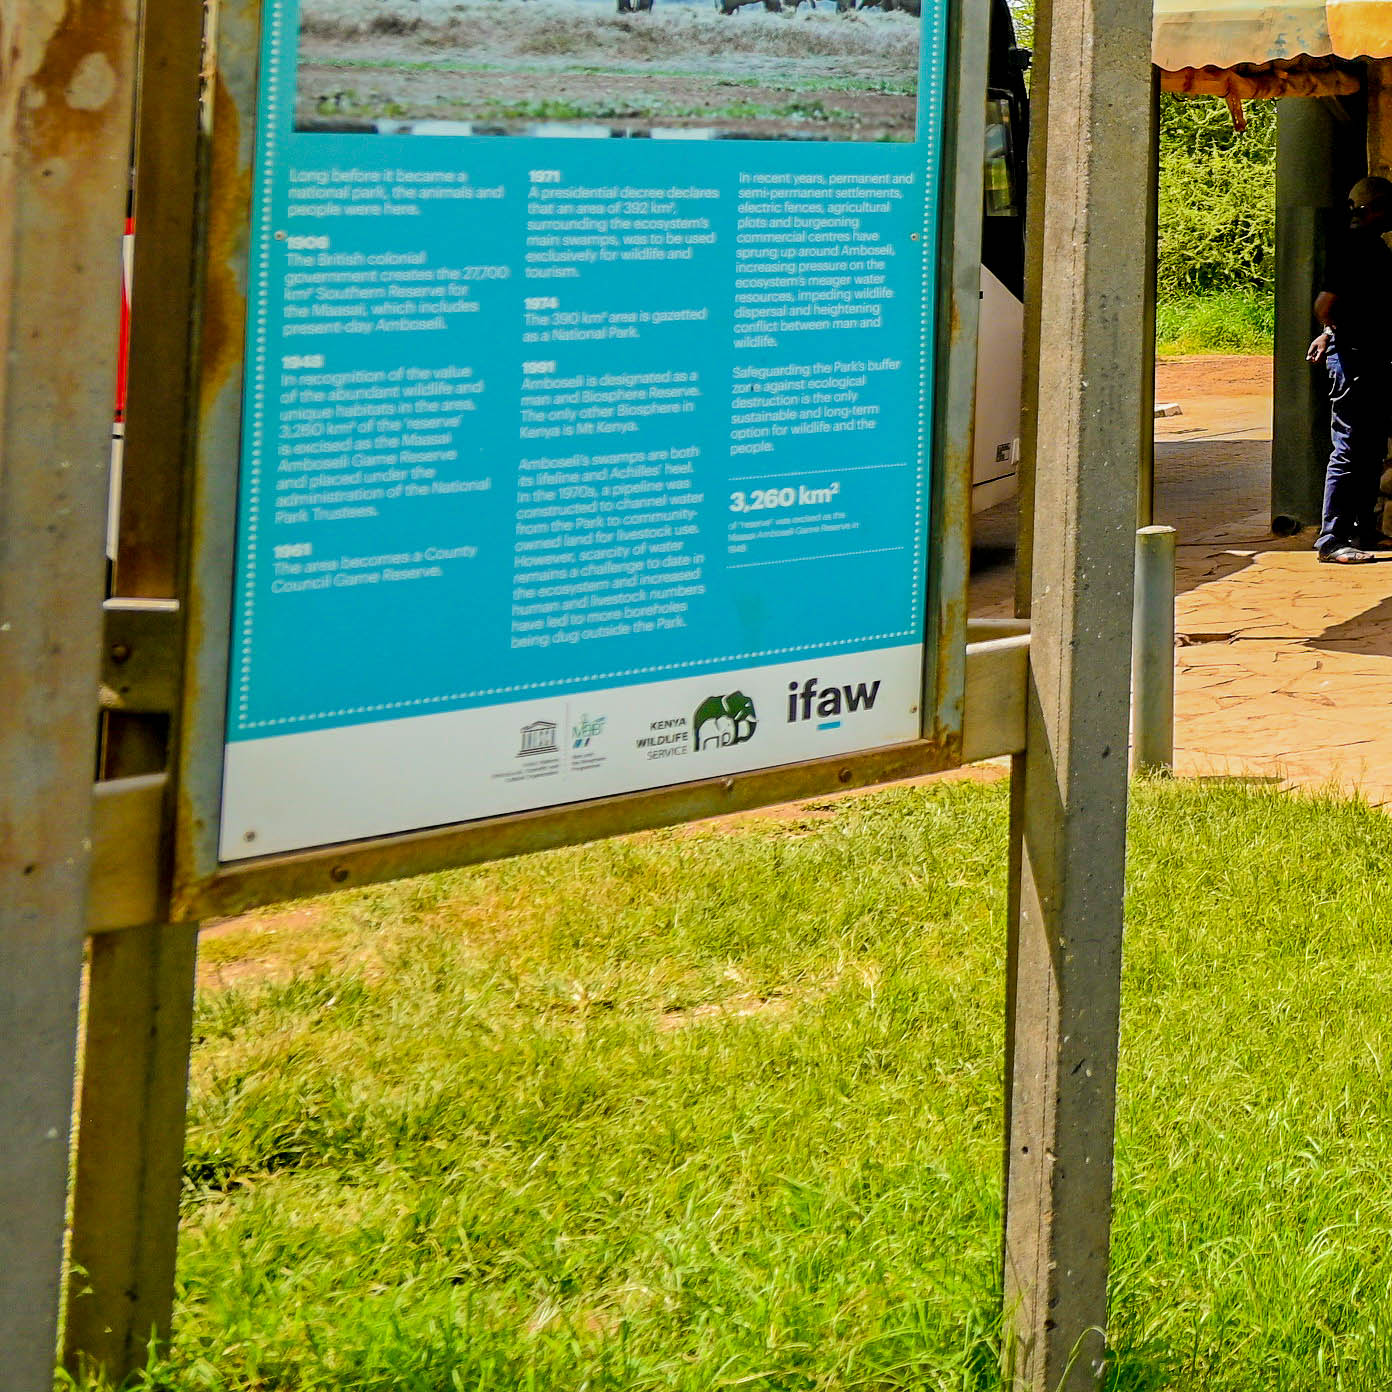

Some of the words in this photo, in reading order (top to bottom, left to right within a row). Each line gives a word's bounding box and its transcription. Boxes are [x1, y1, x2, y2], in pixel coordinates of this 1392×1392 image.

[739, 172, 750, 184] In
[753, 172, 791, 184] recent
[793, 174, 826, 185] years,
[828, 172, 890, 185] permanent
[892, 172, 913, 183] and
[738, 187, 832, 200] semi-permanent
[835, 187, 903, 199] settlements,
[737, 201, 781, 213] electric
[783, 201, 825, 214] fences,
[827, 200, 891, 214] agricultural
[737, 216, 767, 230] plots
[769, 216, 792, 228] and
[794, 215, 859, 229] burgeoning
[736, 230, 805, 243] commercial
[808, 230, 850, 242] centres
[852, 230, 880, 242] have
[736, 248, 779, 260] sprung
[780, 247, 796, 259] up
[798, 245, 839, 257] around
[842, 244, 895, 257] Amboseli,
[736, 260, 797, 274] increasing
[798, 261, 848, 273] pressure
[849, 260, 864, 270] on
[866, 258, 885, 270] the
[735, 274, 806, 290] ecosystem's
[807, 275, 850, 288] meager
[854, 272, 885, 285] water
[735, 291, 795, 303] resources,
[798, 287, 852, 302] impeding
[854, 286, 894, 299] wildlife
[734, 304, 786, 319] dispersal
[789, 304, 810, 316] and
[813, 301, 880, 317] heightening
[733, 319, 778, 332] conflict
[780, 317, 829, 331] between
[832, 318, 856, 329] man
[859, 315, 881, 328] and
[733, 335, 778, 348] wildlife.
[732, 362, 811, 380] Safeguarding
[812, 361, 832, 374] the
[834, 360, 864, 373] Park's
[867, 358, 900, 371] buffer
[731, 382, 761, 393] zone
[763, 377, 805, 393] against
[807, 374, 866, 391] ecological
[731, 393, 798, 408] destruction
[801, 392, 810, 404] is
[812, 391, 831, 403] the
[833, 389, 858, 404] only
[731, 408, 797, 423] sustainable
[799, 406, 821, 419] and
[823, 403, 880, 419] long-term
[730, 424, 769, 440] option
[771, 423, 787, 436] for
[791, 420, 831, 434] wildlife
[833, 419, 856, 432] and
[856, 417, 876, 430] the
[730, 439, 774, 455] people.
[729, 487, 795, 513] 3,260
[799, 482, 840, 505] km²
[786, 678, 882, 724] ifaw
[649, 717, 687, 731] KENYA
[635, 732, 689, 749] WILDLIFE
[646, 745, 688, 760] SERVICE
